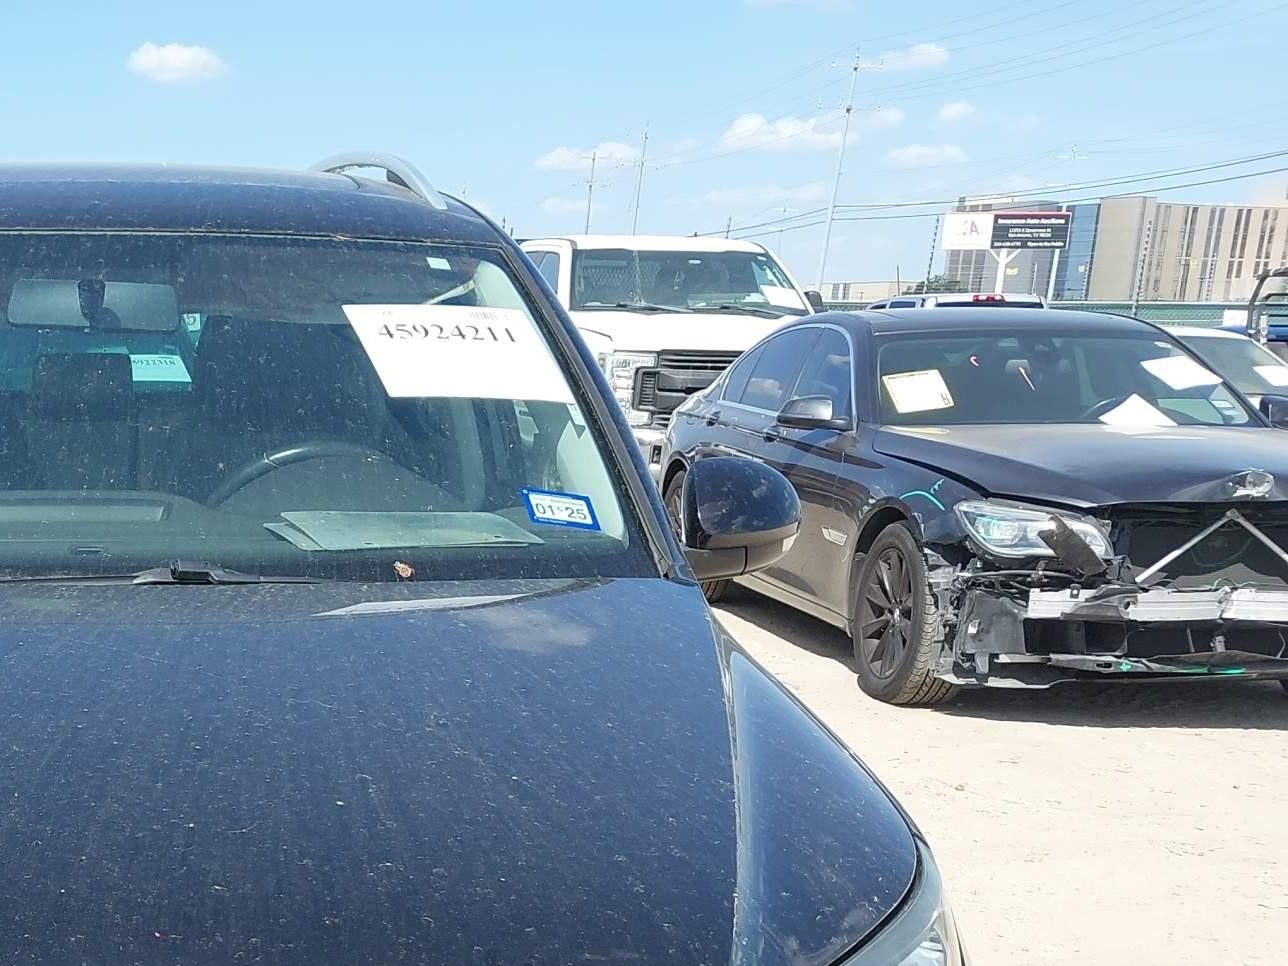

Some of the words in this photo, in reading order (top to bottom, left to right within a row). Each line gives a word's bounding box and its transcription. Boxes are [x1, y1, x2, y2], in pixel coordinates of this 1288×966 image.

[378, 323, 516, 343] 45924211
[535, 503, 556, 516] 01
[564, 506, 587, 520] 25
